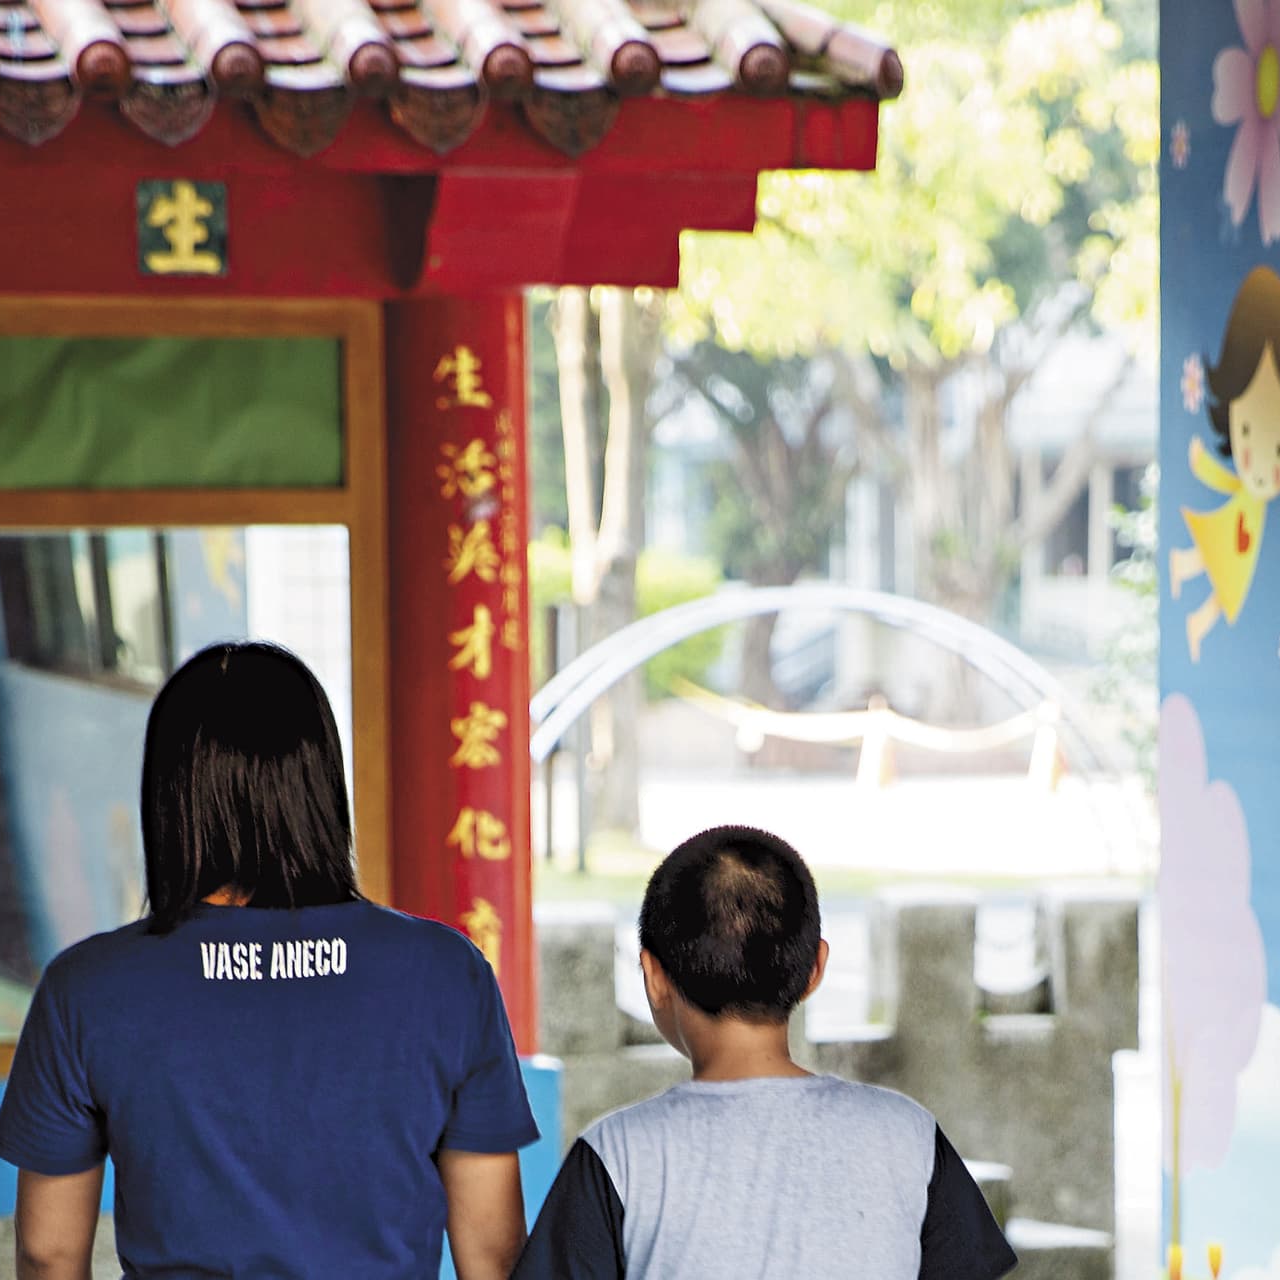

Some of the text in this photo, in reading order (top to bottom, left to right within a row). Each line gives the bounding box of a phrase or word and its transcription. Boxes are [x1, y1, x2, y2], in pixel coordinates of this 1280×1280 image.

[145, 181, 224, 275] 生
[200, 937, 347, 980] VASE ANECO
